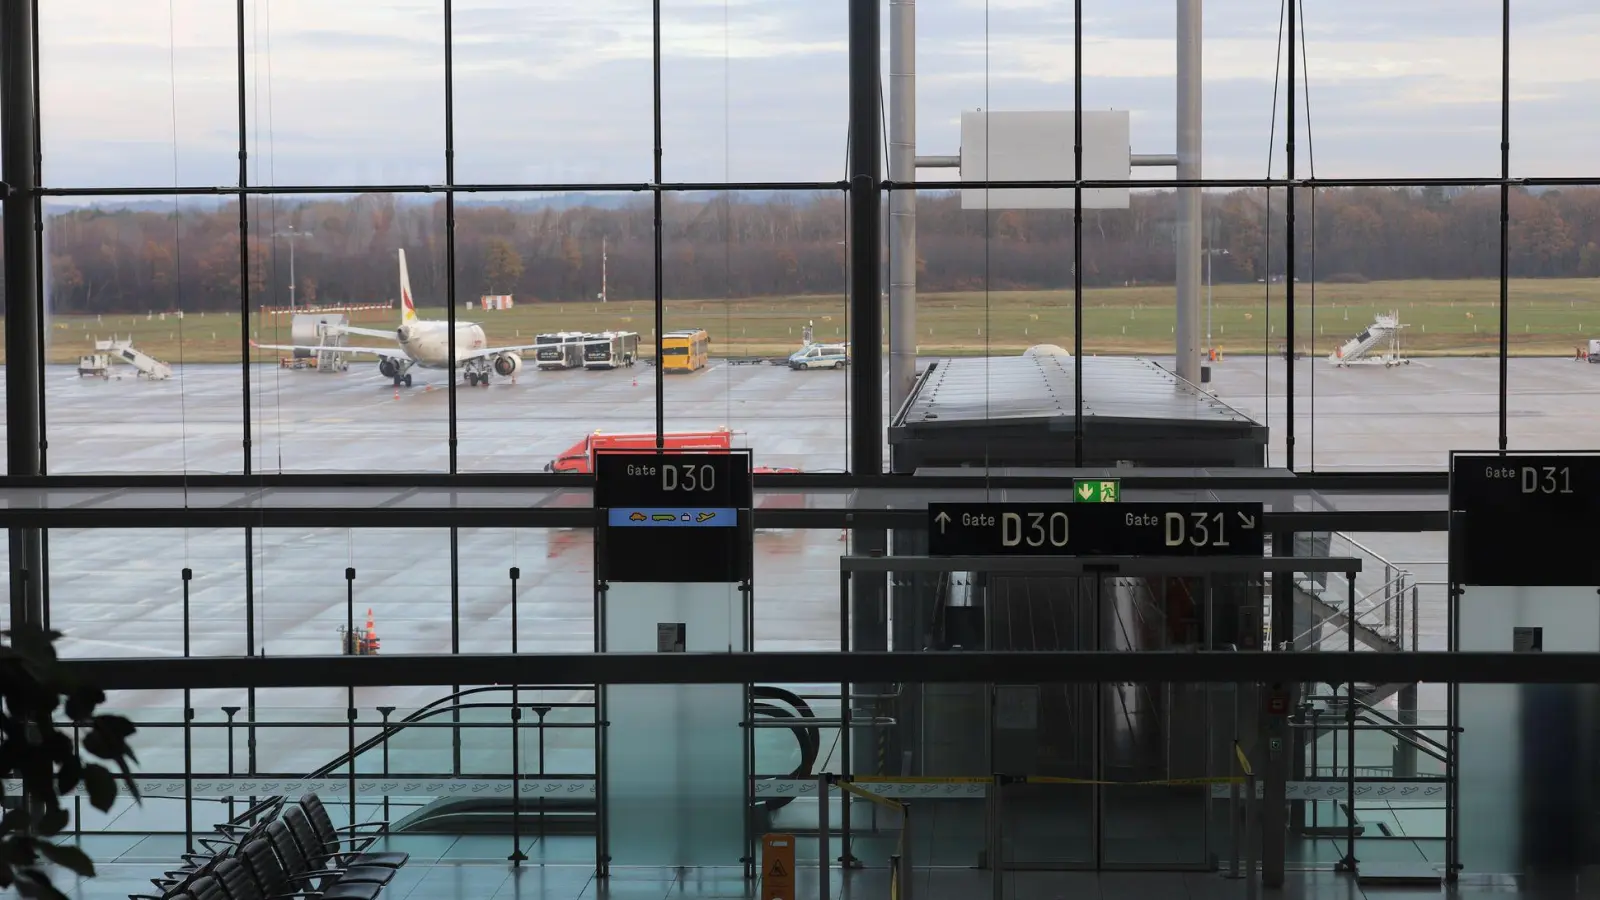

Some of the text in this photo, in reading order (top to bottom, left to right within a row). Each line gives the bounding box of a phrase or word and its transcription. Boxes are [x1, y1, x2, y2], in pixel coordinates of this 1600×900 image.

[627, 464, 715, 492] Gate D30
[1485, 466, 1574, 494] Gate D31
[962, 511, 1069, 547] Gate D30
[1125, 511, 1230, 547] Gate D31
